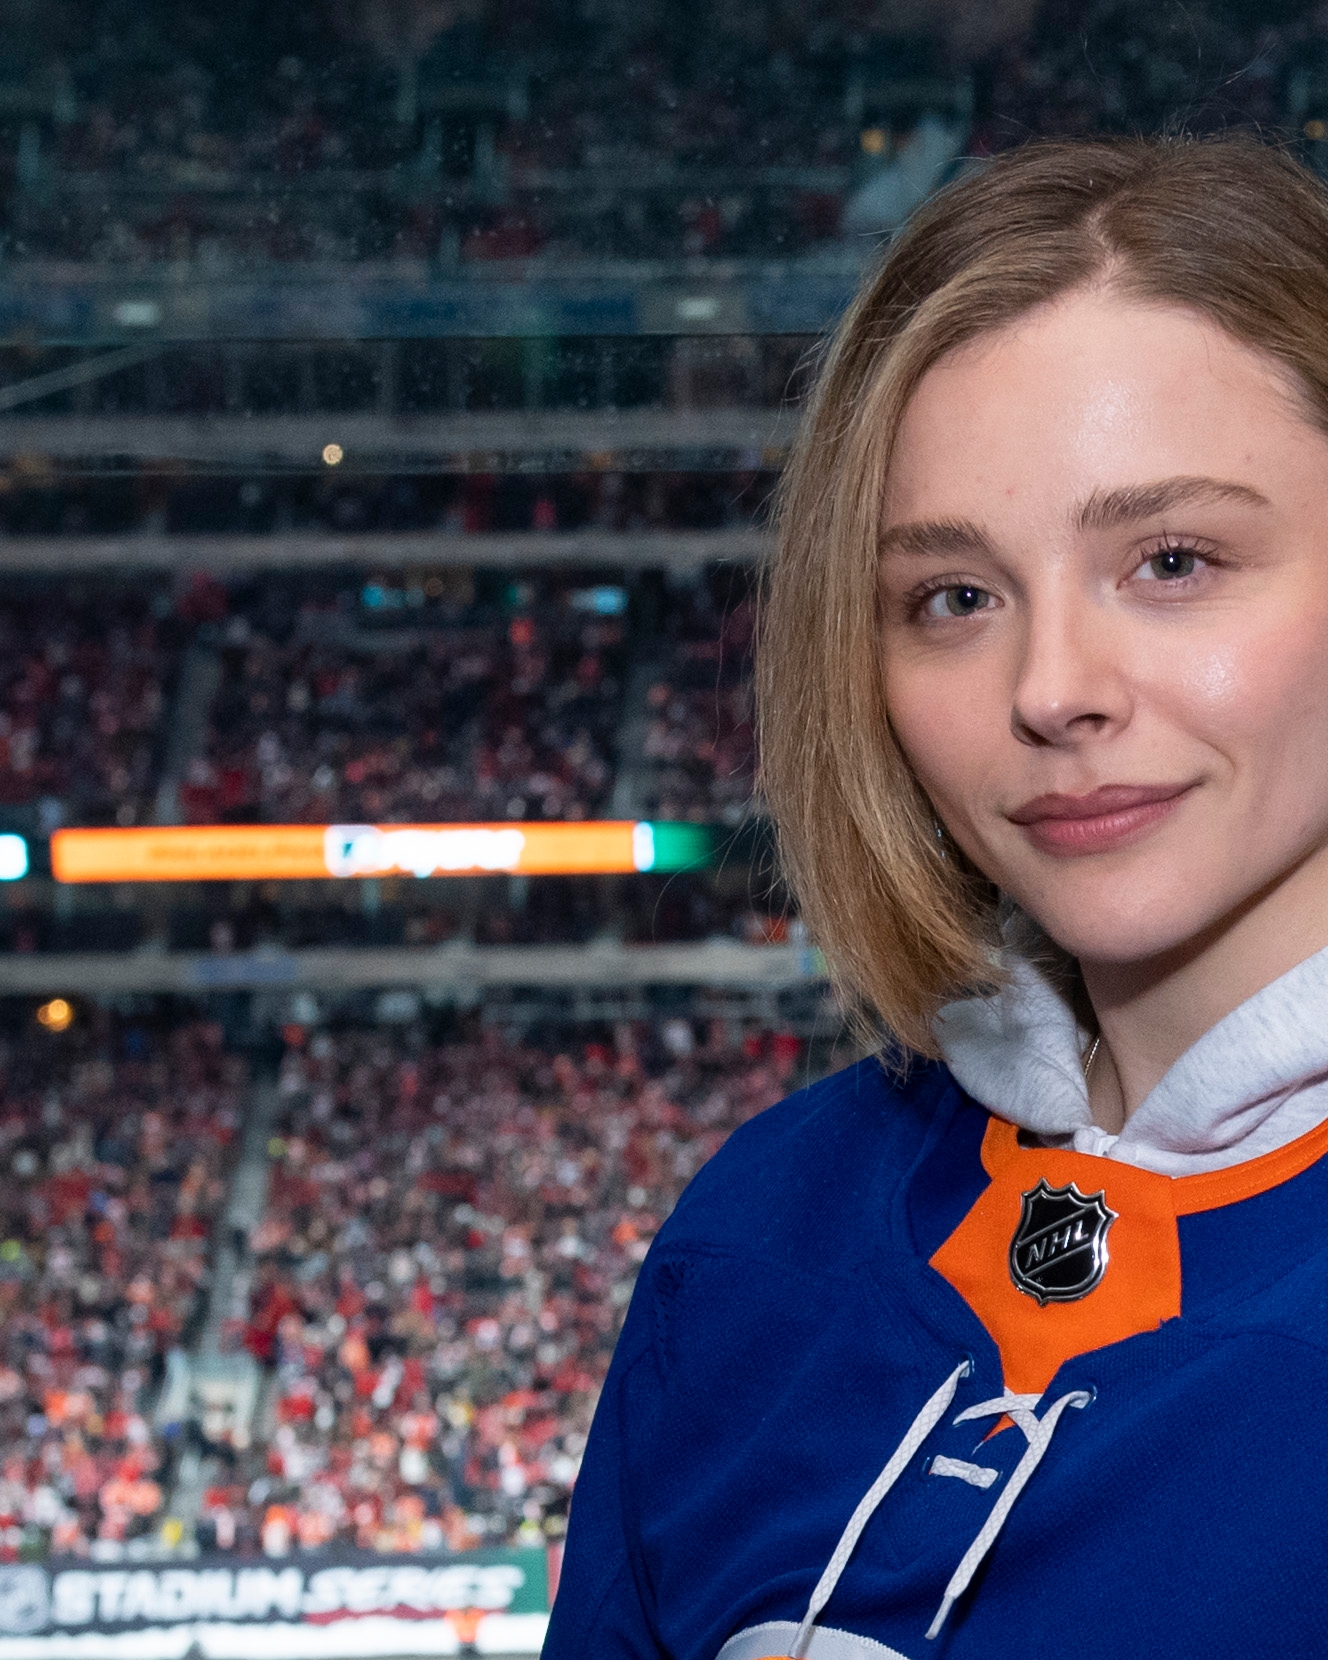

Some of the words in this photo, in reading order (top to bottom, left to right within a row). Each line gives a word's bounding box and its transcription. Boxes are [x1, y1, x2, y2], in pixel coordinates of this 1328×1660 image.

[1024, 1219, 1090, 1270] NHL
[52, 1568, 300, 1626] STADIUM
[301, 1566, 525, 1612] SERIES
